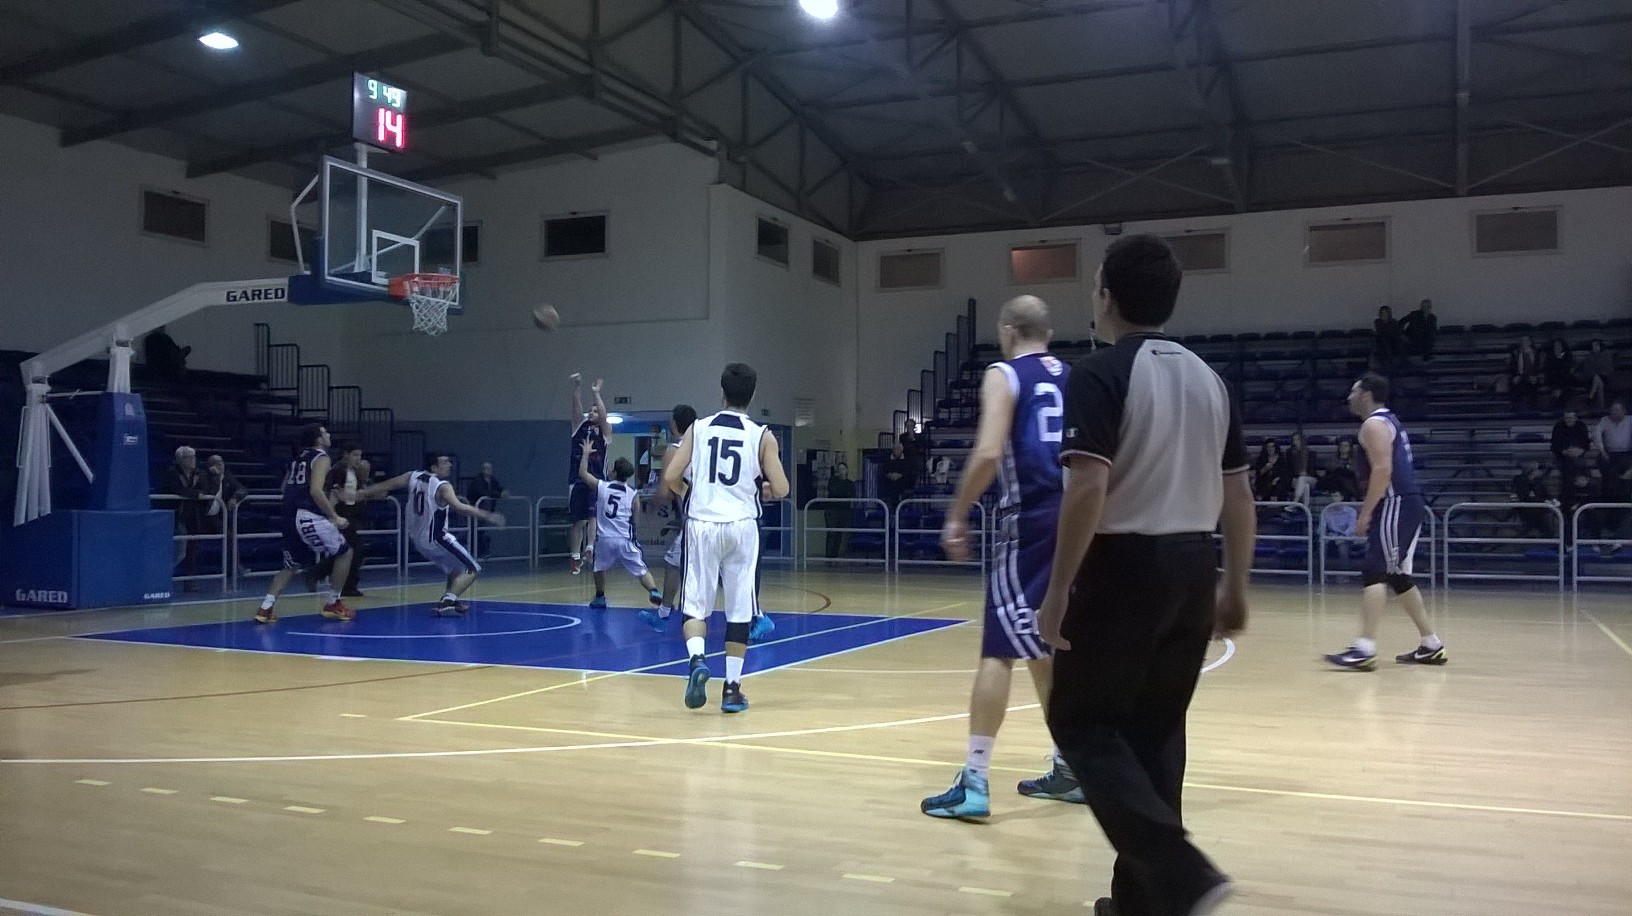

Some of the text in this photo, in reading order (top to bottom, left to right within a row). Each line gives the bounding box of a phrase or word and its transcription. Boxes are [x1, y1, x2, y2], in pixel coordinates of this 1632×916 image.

[368, 79, 378, 100] 9
[377, 107, 404, 149] 14
[226, 286, 286, 303] GARED
[287, 460, 307, 485] 18
[707, 436, 744, 487] 15
[605, 494, 622, 520] 5
[15, 588, 69, 604] GARED
[143, 591, 171, 600] GARED
